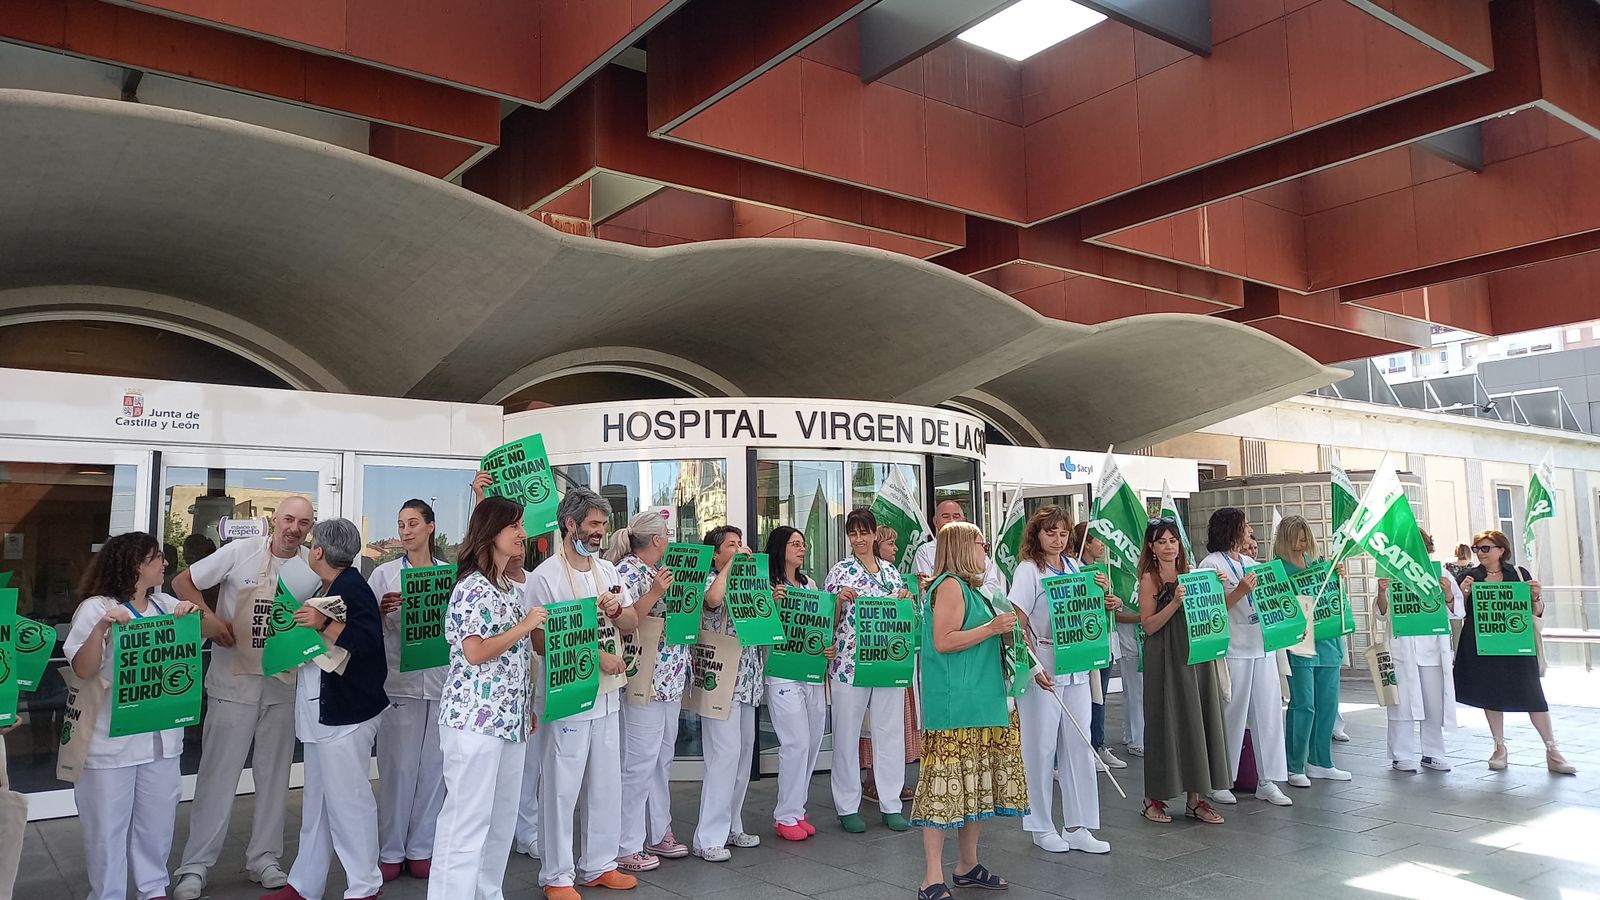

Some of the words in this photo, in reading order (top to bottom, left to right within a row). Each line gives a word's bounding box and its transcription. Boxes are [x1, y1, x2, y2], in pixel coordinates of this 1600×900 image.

[149, 409, 181, 418] Junta
[116, 417, 157, 427] Castilla
[161, 422, 168, 430] y
[172, 421, 199, 429] León
[604, 410, 777, 442] HOSPITAL
[795, 411, 913, 443] VIRGEN
[922, 418, 950, 447] DE
[956, 422, 972, 451] LA
[484, 456, 505, 471] QUE
[508, 450, 525, 464] NO
[502, 458, 546, 480] COMAN
[1077, 464, 1093, 474] Sacyl
[504, 480, 523, 496] UN
[229, 528, 259, 536] respeto
[1096, 518, 1140, 568] SATS
[666, 555, 683, 567] QUE
[684, 556, 698, 568] NO
[1368, 532, 1439, 596] SATSE
[675, 570, 705, 583] COMAN
[731, 564, 744, 576] QUE
[746, 565, 756, 576] NO
[729, 579, 737, 590] SE
[740, 579, 768, 590] COMAN
[1265, 572, 1275, 584] NO
[1297, 575, 1315, 588] QUE
[1316, 572, 1326, 583] NO
[407, 579, 431, 594] QUE
[435, 577, 451, 590] NO
[672, 585, 683, 598] UN
[1050, 586, 1071, 599] QUE
[1073, 584, 1086, 598] NO
[1200, 582, 1210, 594] NO
[1255, 588, 1264, 600] SE
[1264, 581, 1290, 597] COMAN
[1392, 583, 1402, 592] SE
[406, 596, 420, 609] SE
[424, 592, 449, 606] COM
[729, 593, 738, 604] NI
[740, 593, 753, 604] UN
[1393, 594, 1403, 603] NI
[1405, 593, 1420, 602] UN
[1476, 591, 1496, 600] QUE
[1499, 590, 1513, 600] NO
[781, 598, 801, 610] QUE
[804, 600, 818, 613] NO
[1053, 602, 1064, 614] SE
[1067, 597, 1101, 612] COMAN
[1185, 598, 1195, 610] SE
[1197, 594, 1223, 608] COMAN
[1258, 601, 1268, 613] NI
[1269, 598, 1280, 610] UN
[1477, 602, 1488, 611] SE
[1492, 602, 1527, 610] COMAN
[254, 605, 272, 614] QUE
[553, 607, 570, 615] NUESTRA
[570, 604, 582, 612] EXTRA
[732, 607, 756, 618] EURO
[859, 607, 879, 619] QUE
[883, 607, 897, 619] NO
[1314, 608, 1330, 621] URO
[1394, 604, 1420, 614] EURO
[252, 616, 263, 625] SE
[406, 611, 418, 625] NI
[422, 608, 440, 623] UN
[780, 611, 791, 624] SE
[794, 613, 830, 628] COMAN
[1054, 616, 1065, 629] NI
[1068, 614, 1081, 628] UN
[1188, 612, 1197, 623] NI
[1198, 609, 1210, 621] UN
[1262, 610, 1284, 626] EURO
[1478, 612, 1488, 621] NI
[1491, 612, 1505, 621] UN
[129, 622, 155, 630] NUESTRA
[548, 616, 567, 633] QUE
[570, 613, 582, 629] NO
[860, 621, 871, 633] SE
[875, 621, 911, 633] COMAN
[1479, 624, 1506, 633] EURO
[252, 627, 261, 636] NI
[406, 624, 440, 641] EURO
[791, 627, 805, 640] UN
[1056, 629, 1084, 645] EURO
[1191, 623, 1210, 638] EURO
[120, 631, 150, 650] QUE
[155, 628, 175, 645] NO
[550, 634, 560, 651] SE
[563, 628, 595, 648] COMAN
[860, 635, 870, 646] NI
[874, 635, 888, 646] UN
[120, 651, 138, 668] SE
[143, 642, 196, 664] COMAN
[550, 653, 560, 669] NI
[563, 649, 576, 666] UN
[860, 649, 888, 661] EURO
[120, 668, 136, 685] NI
[140, 665, 162, 682] UN
[550, 666, 576, 688] EURO
[119, 682, 162, 703] EURO
